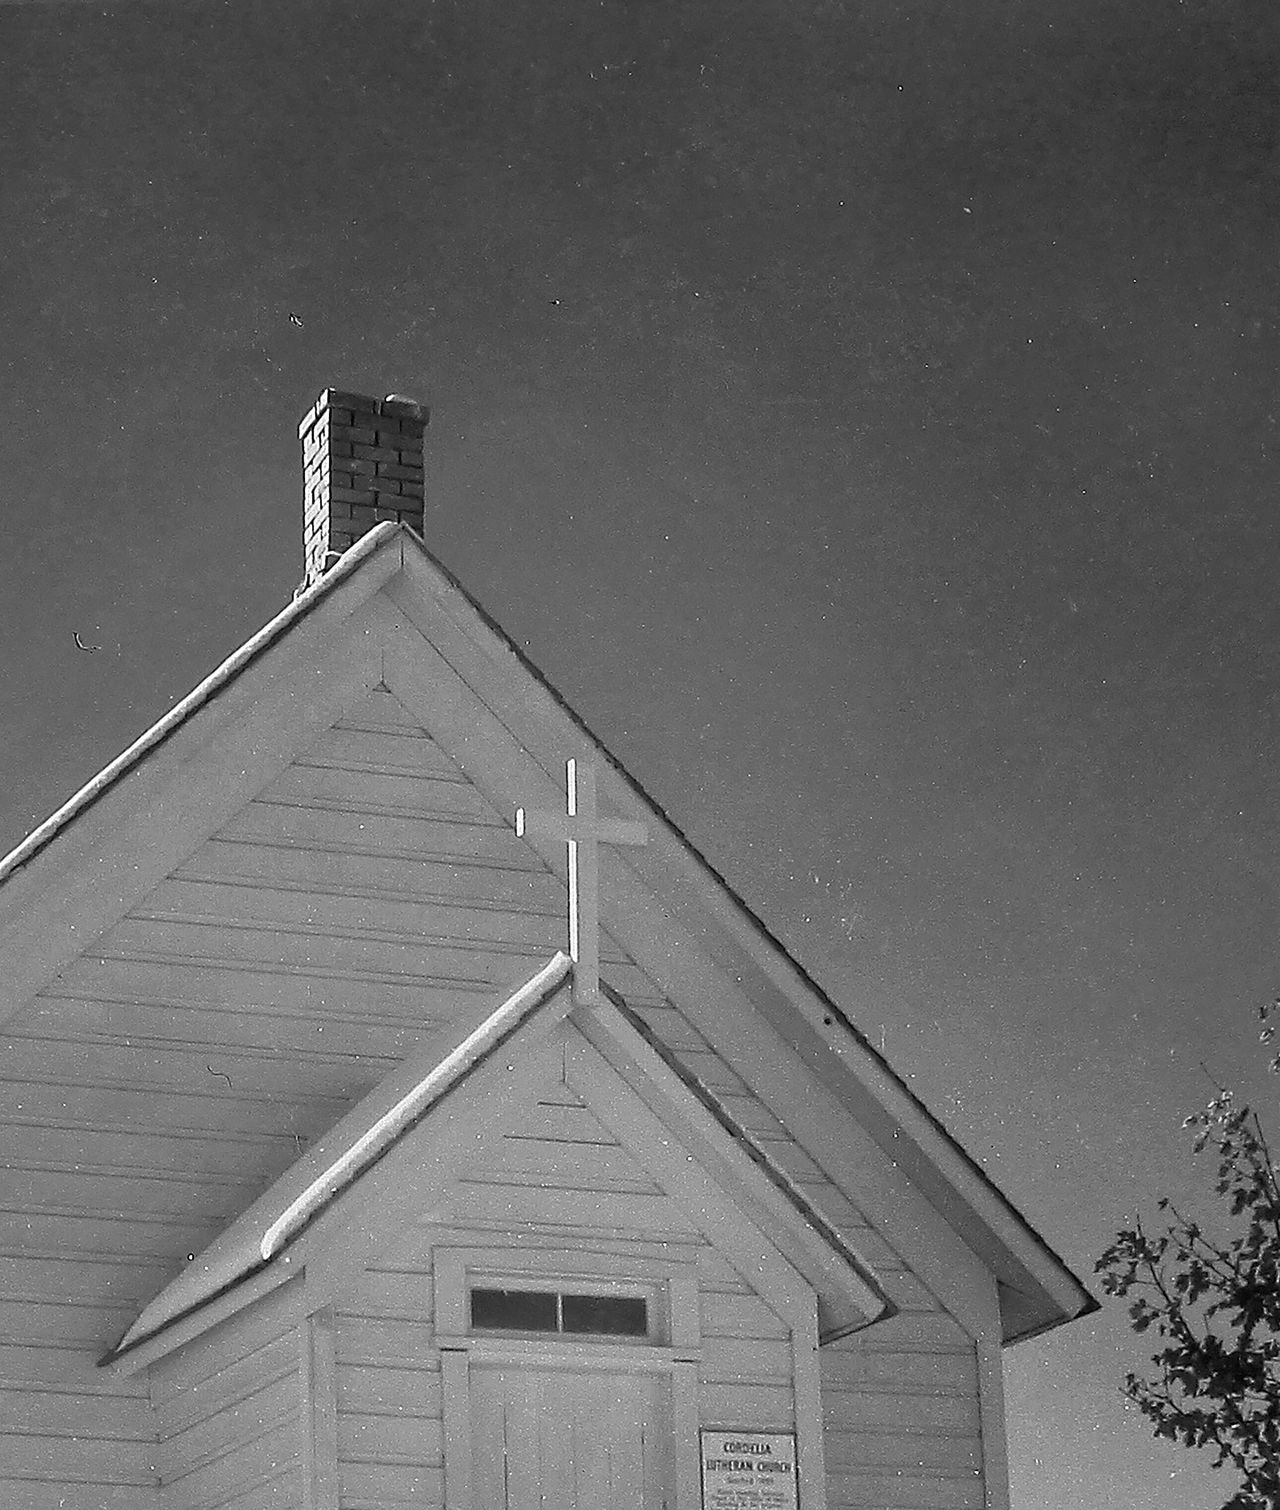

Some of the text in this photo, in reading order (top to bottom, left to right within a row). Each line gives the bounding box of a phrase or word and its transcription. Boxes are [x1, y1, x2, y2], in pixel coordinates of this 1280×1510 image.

[723, 1442, 772, 1455] CORDELIA
[706, 1460, 791, 1473] LUTHERAN CHURCH
